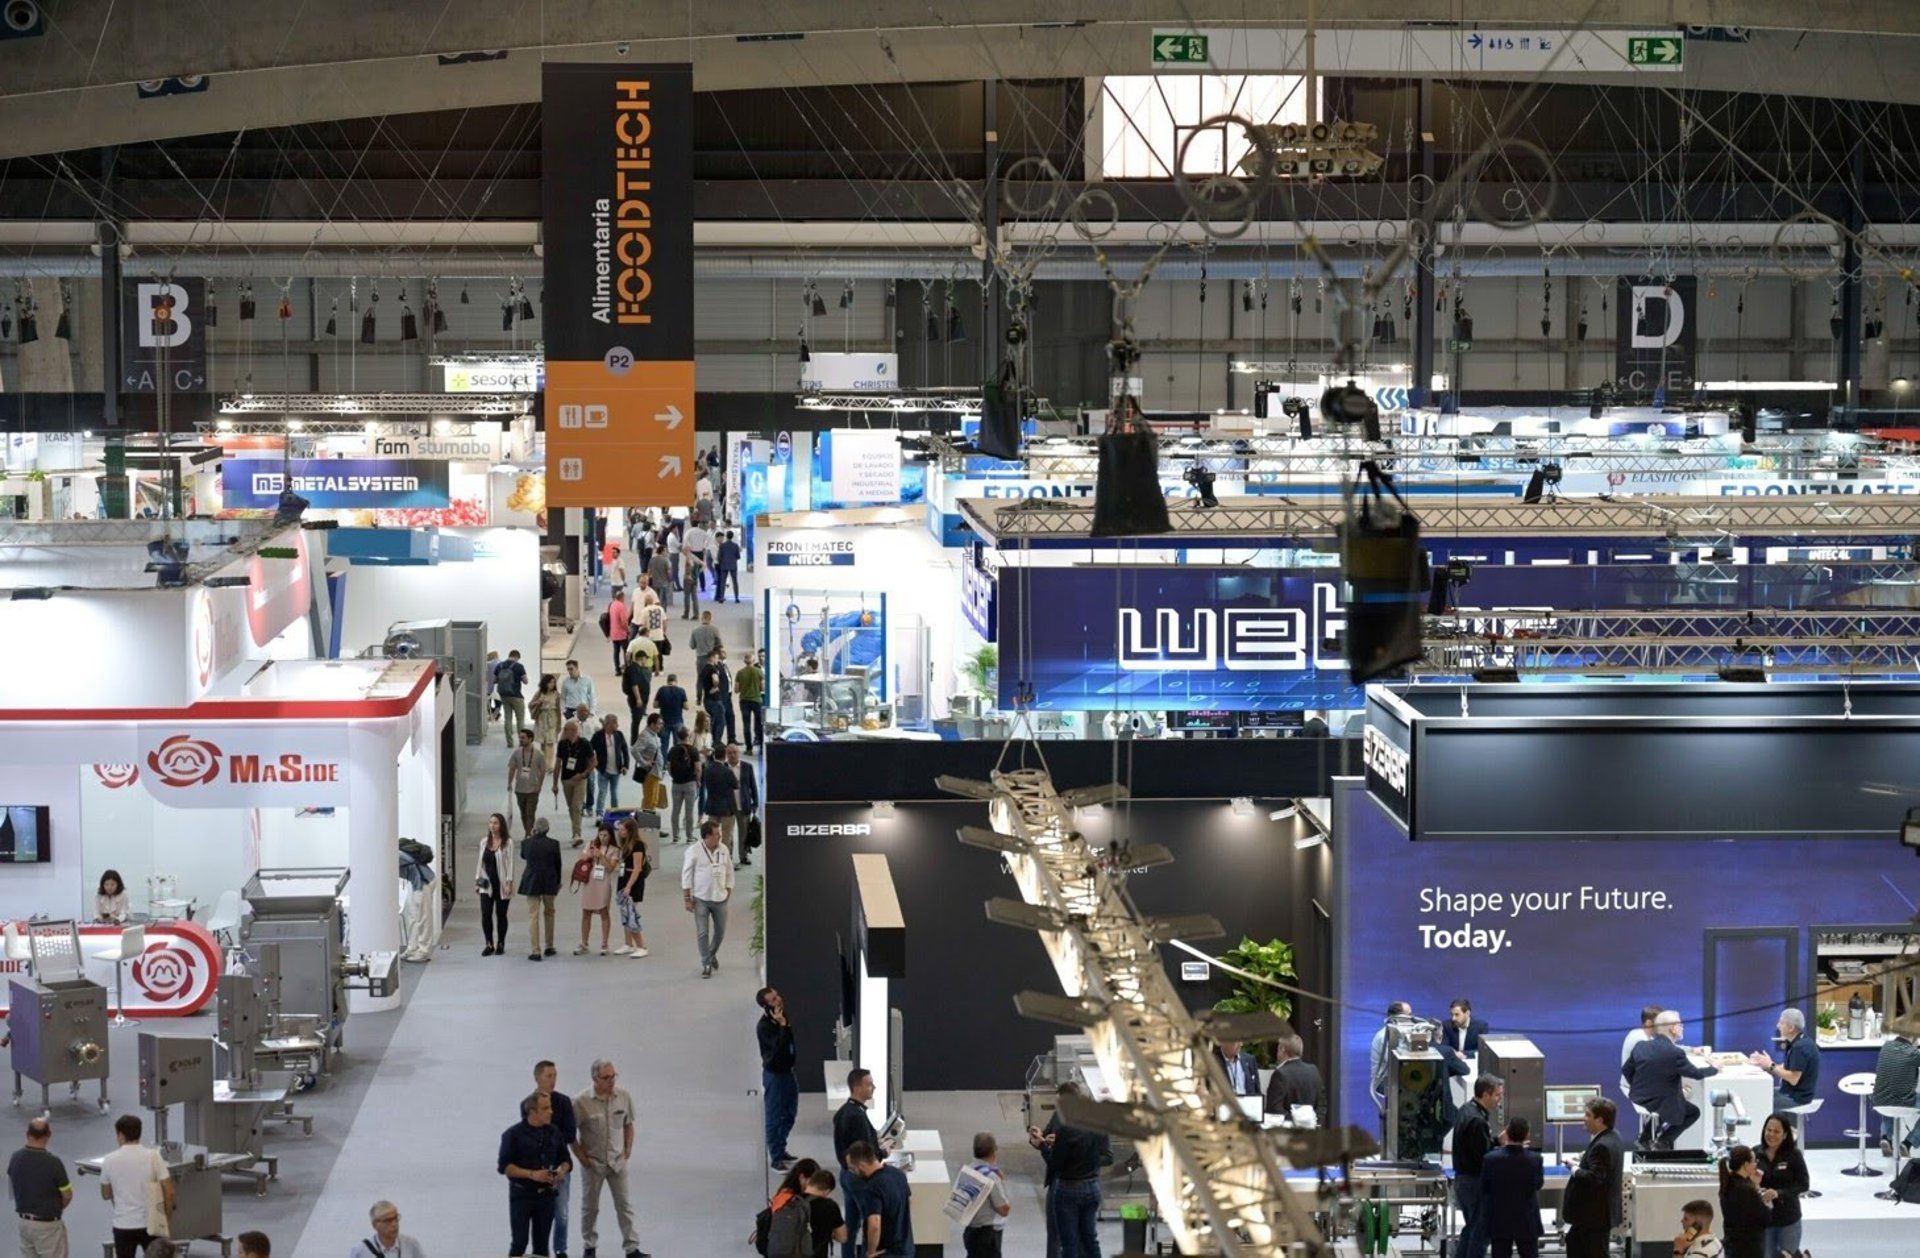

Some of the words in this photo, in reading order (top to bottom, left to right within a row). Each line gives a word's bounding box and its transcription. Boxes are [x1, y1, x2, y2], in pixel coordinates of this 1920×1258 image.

[616, 81, 651, 324] FOODTECH
[592, 198, 611, 324] Alimentaria
[138, 283, 191, 347] B
[1632, 285, 1684, 348] D
[609, 356, 629, 368] P2
[138, 370, 155, 390] A
[175, 369, 192, 390] C
[1628, 370, 1645, 391] C
[1667, 370, 1682, 390] E
[1720, 484, 1920, 496] FRONTMATE
[767, 541, 853, 551] FRONTMATEC
[786, 824, 872, 836] BIZERBA
[1420, 887, 1503, 917] Shape
[1511, 891, 1572, 917] your
[1580, 886, 1673, 910] Future.
[1418, 923, 1512, 954] Today.
